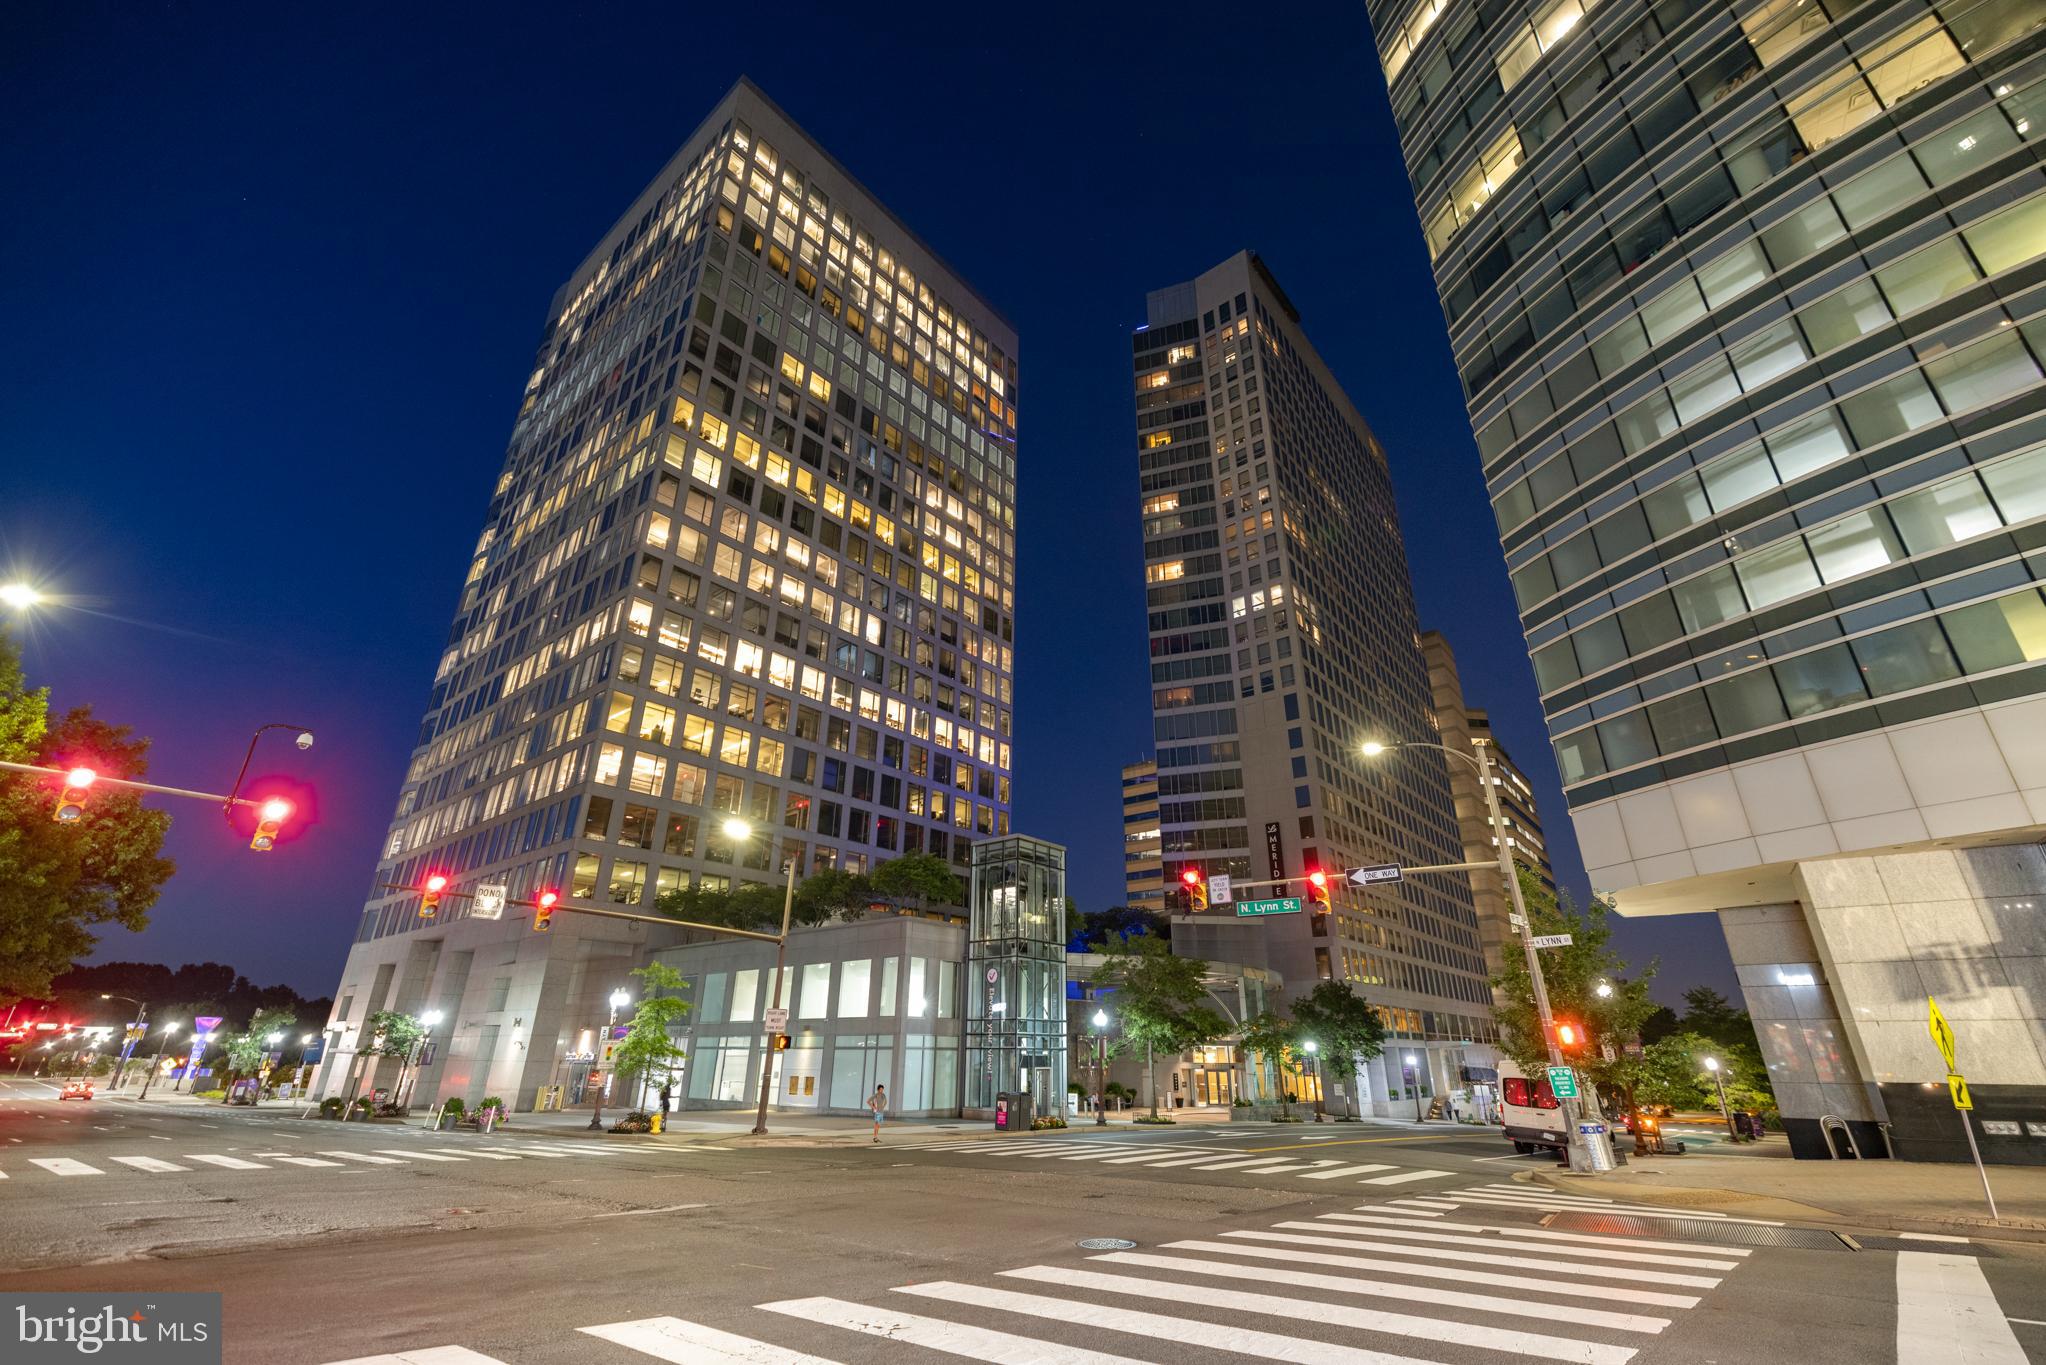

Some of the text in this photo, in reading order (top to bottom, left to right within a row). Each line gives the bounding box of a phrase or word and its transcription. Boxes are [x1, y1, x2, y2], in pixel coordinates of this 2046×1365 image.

[1269, 835, 1282, 896] MERIDE
[1364, 869, 1396, 880] ONE WAY
[1241, 900, 1297, 914] N. Lynn St.
[1541, 937, 1562, 946] LYNN
